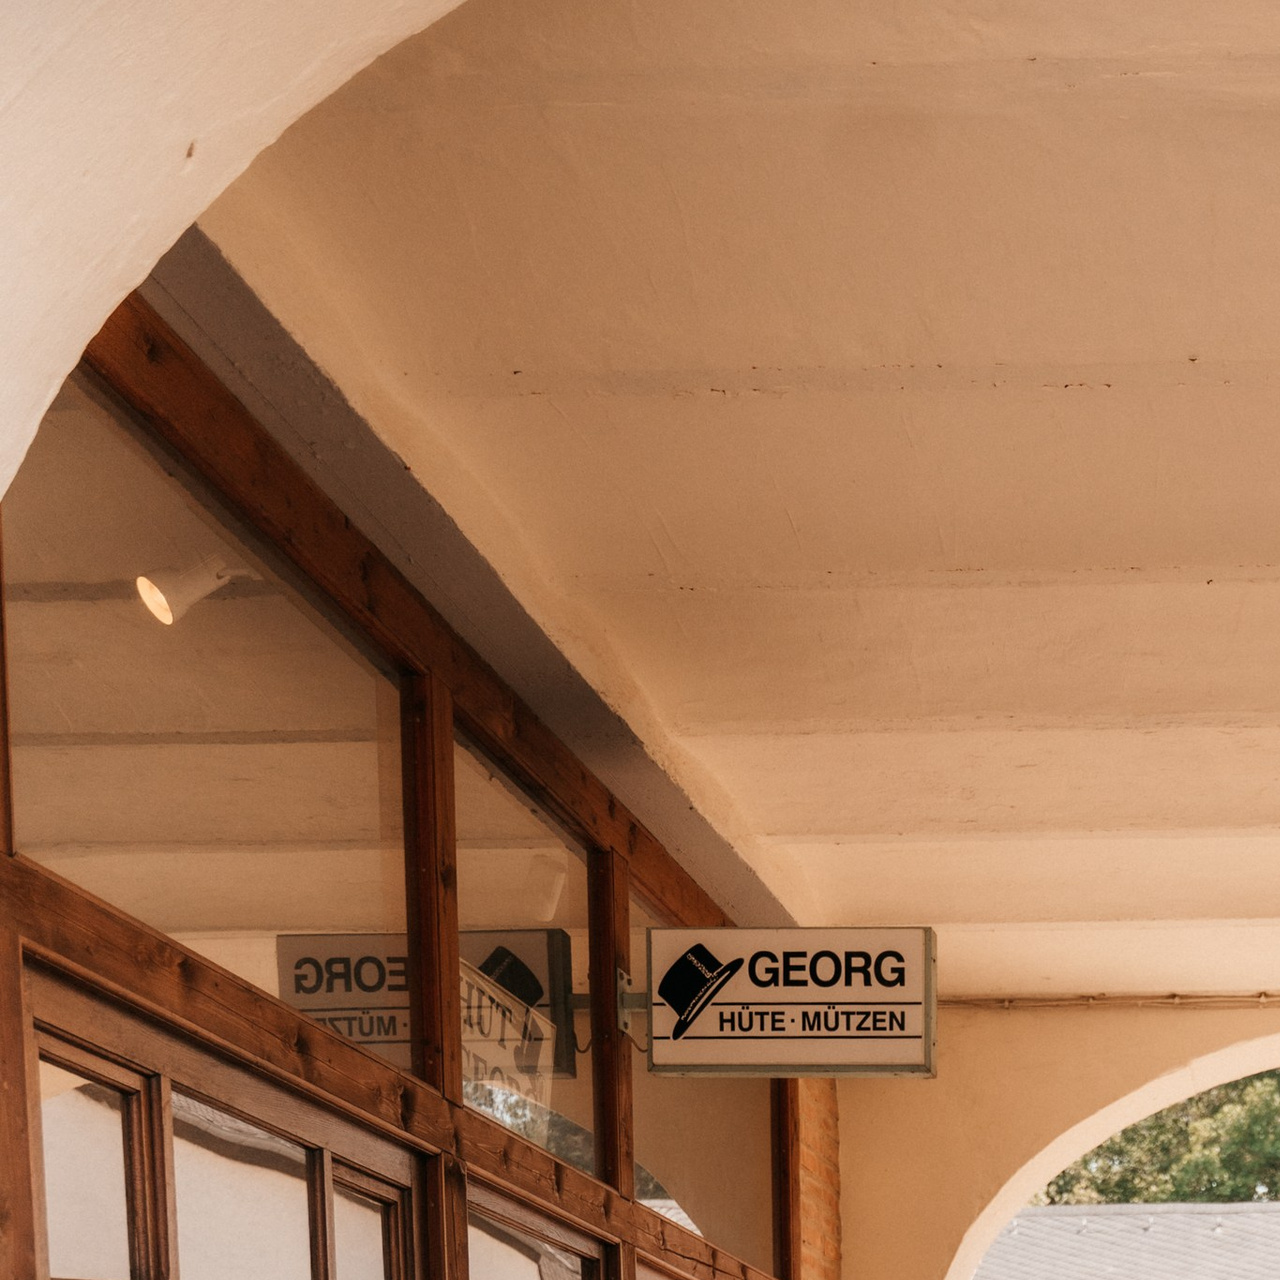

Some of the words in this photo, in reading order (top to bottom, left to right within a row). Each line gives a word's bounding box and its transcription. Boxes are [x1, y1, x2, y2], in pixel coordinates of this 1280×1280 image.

[748, 950, 906, 988] GEORG
[718, 1006, 786, 1032] HÜTE
[801, 1005, 906, 1032] MÜTZEN
